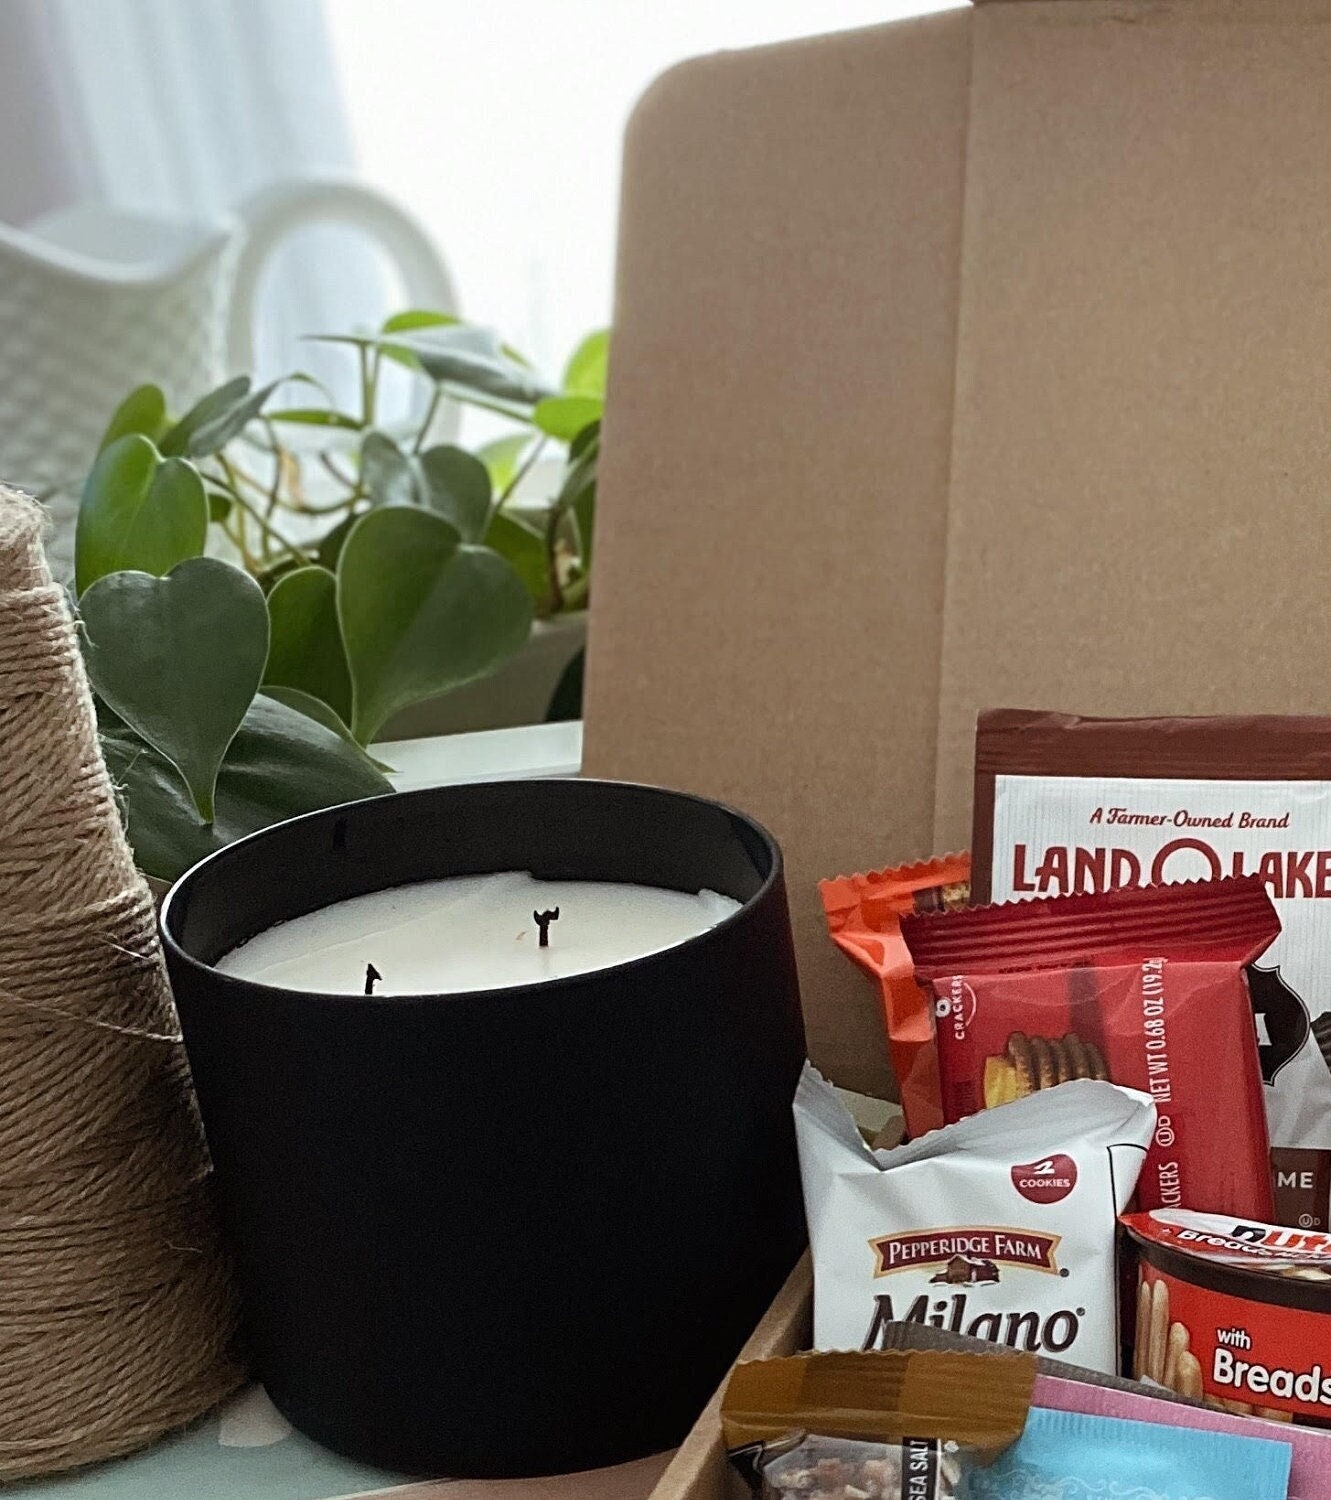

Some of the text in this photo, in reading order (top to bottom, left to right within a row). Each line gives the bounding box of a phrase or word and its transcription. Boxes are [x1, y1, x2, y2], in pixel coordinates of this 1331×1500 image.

[1089, 807, 1290, 829] A Farmer-Owned Brand
[1012, 844, 1140, 893] LAND
[1144, 997, 1164, 1016] OZ
[1144, 1018, 1167, 1050] 0.68
[1148, 1053, 1169, 1077] WT
[1150, 1078, 1172, 1104] NET
[1035, 1161, 1055, 1175] 2
[1019, 1178, 1071, 1189] COOKIES
[1158, 1162, 1181, 1213] CKERS
[889, 1235, 1042, 1264] PEPPERIDGE FARM
[862, 1294, 1079, 1352] Milano
[1216, 1328, 1251, 1350] with
[915, 1440, 930, 1471] SALT
